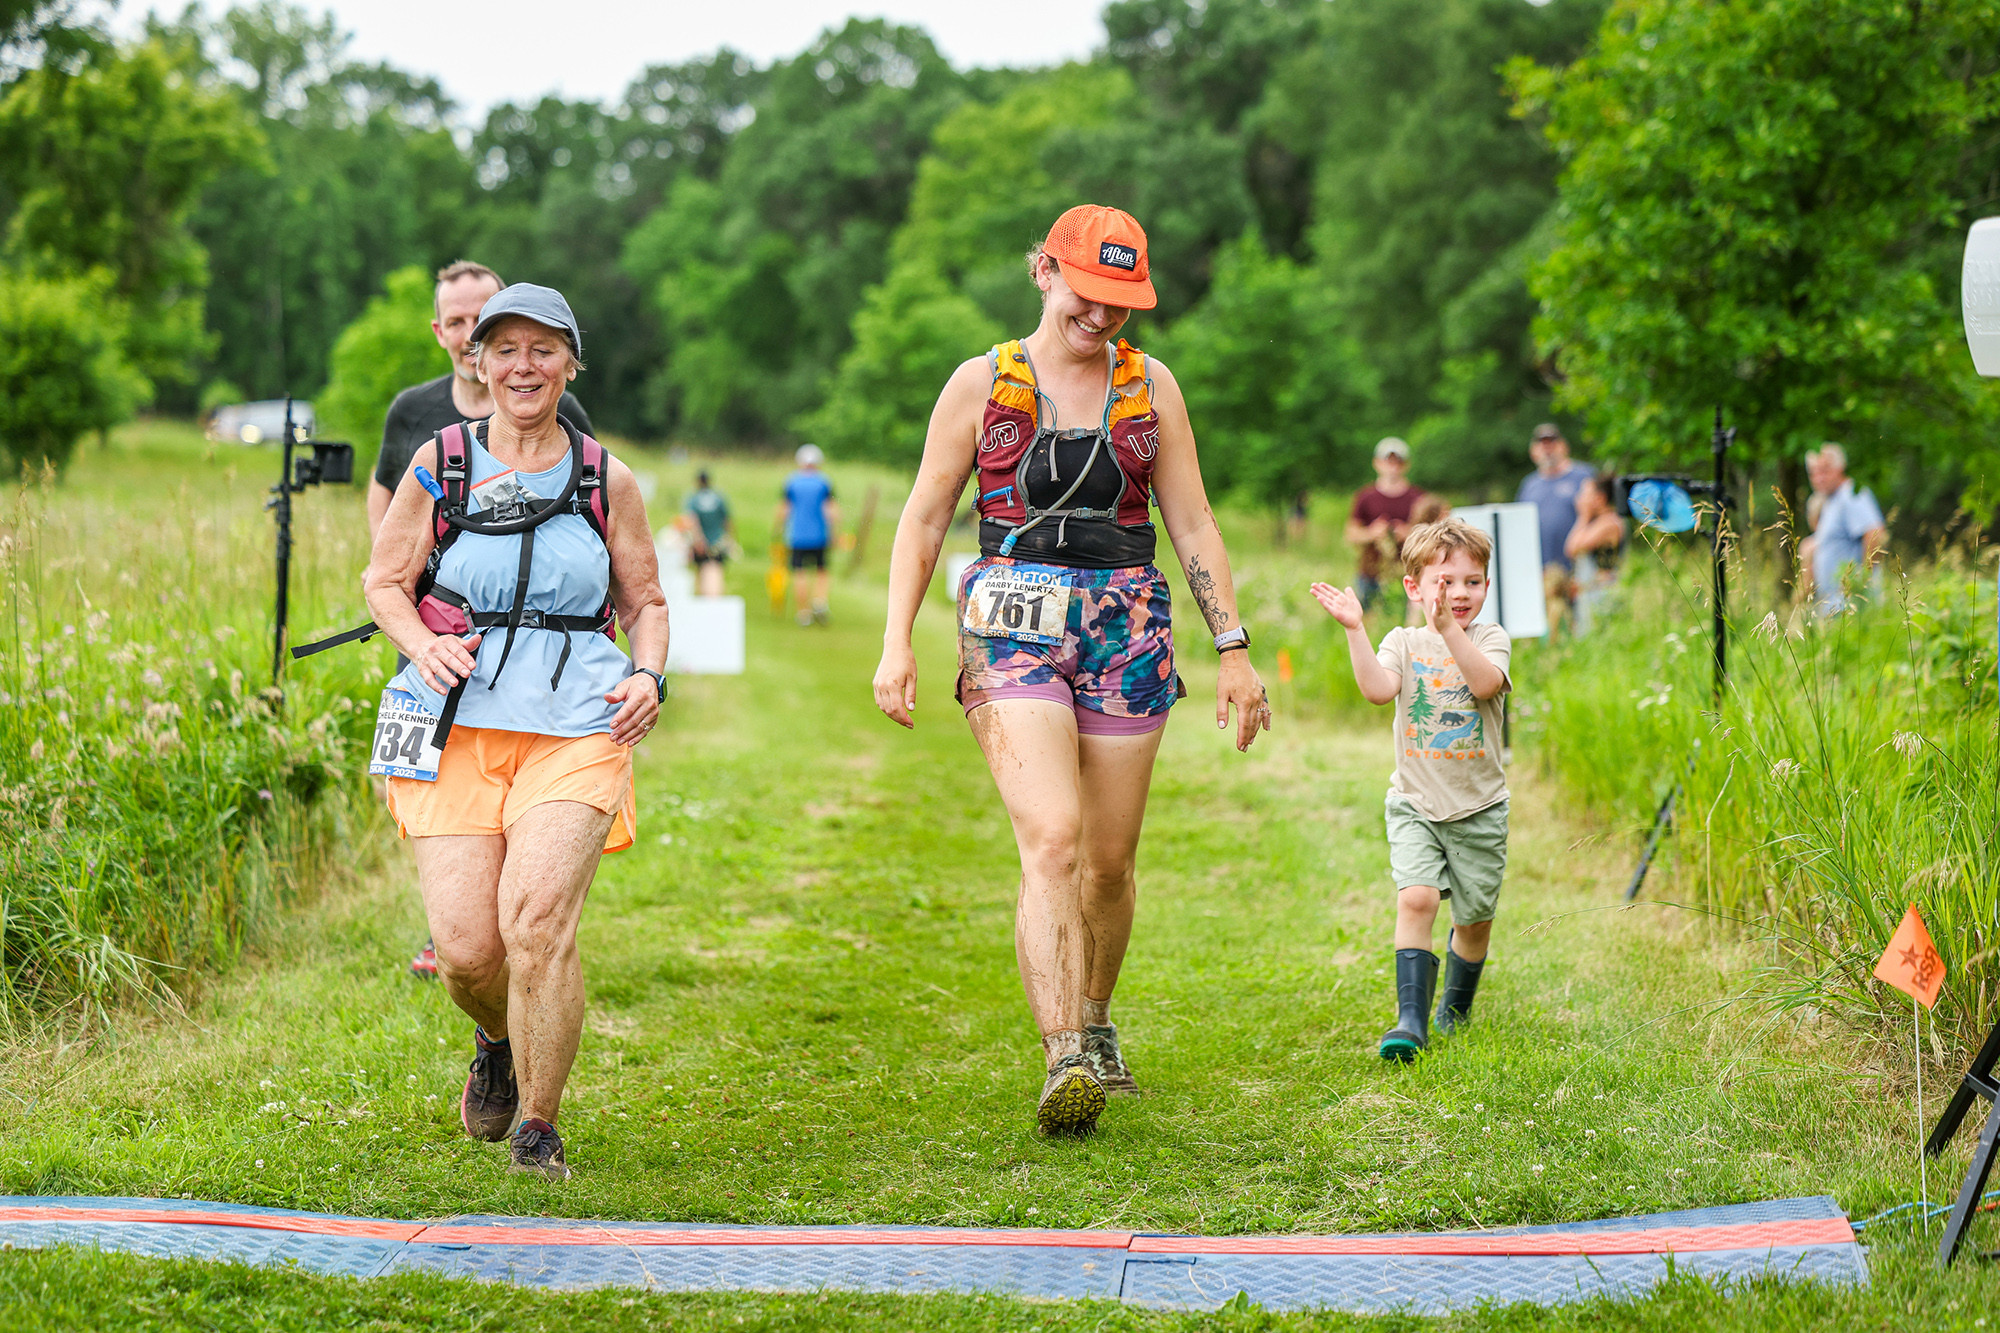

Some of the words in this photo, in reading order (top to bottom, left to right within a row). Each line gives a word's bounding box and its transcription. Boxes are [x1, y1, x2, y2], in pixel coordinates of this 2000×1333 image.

[1102, 246, 1134, 263] Afton
[1012, 571, 1062, 586] AFTON
[985, 581, 1012, 590] DARBY
[1014, 583, 1055, 594] LENERTZ
[986, 590, 1043, 631] 761
[982, 629, 1010, 638] 25KM
[1016, 633, 1039, 643] 2025
[398, 713, 440, 726] KENNEDY
[372, 722, 426, 765] 734
[392, 767, 417, 778] 2025
